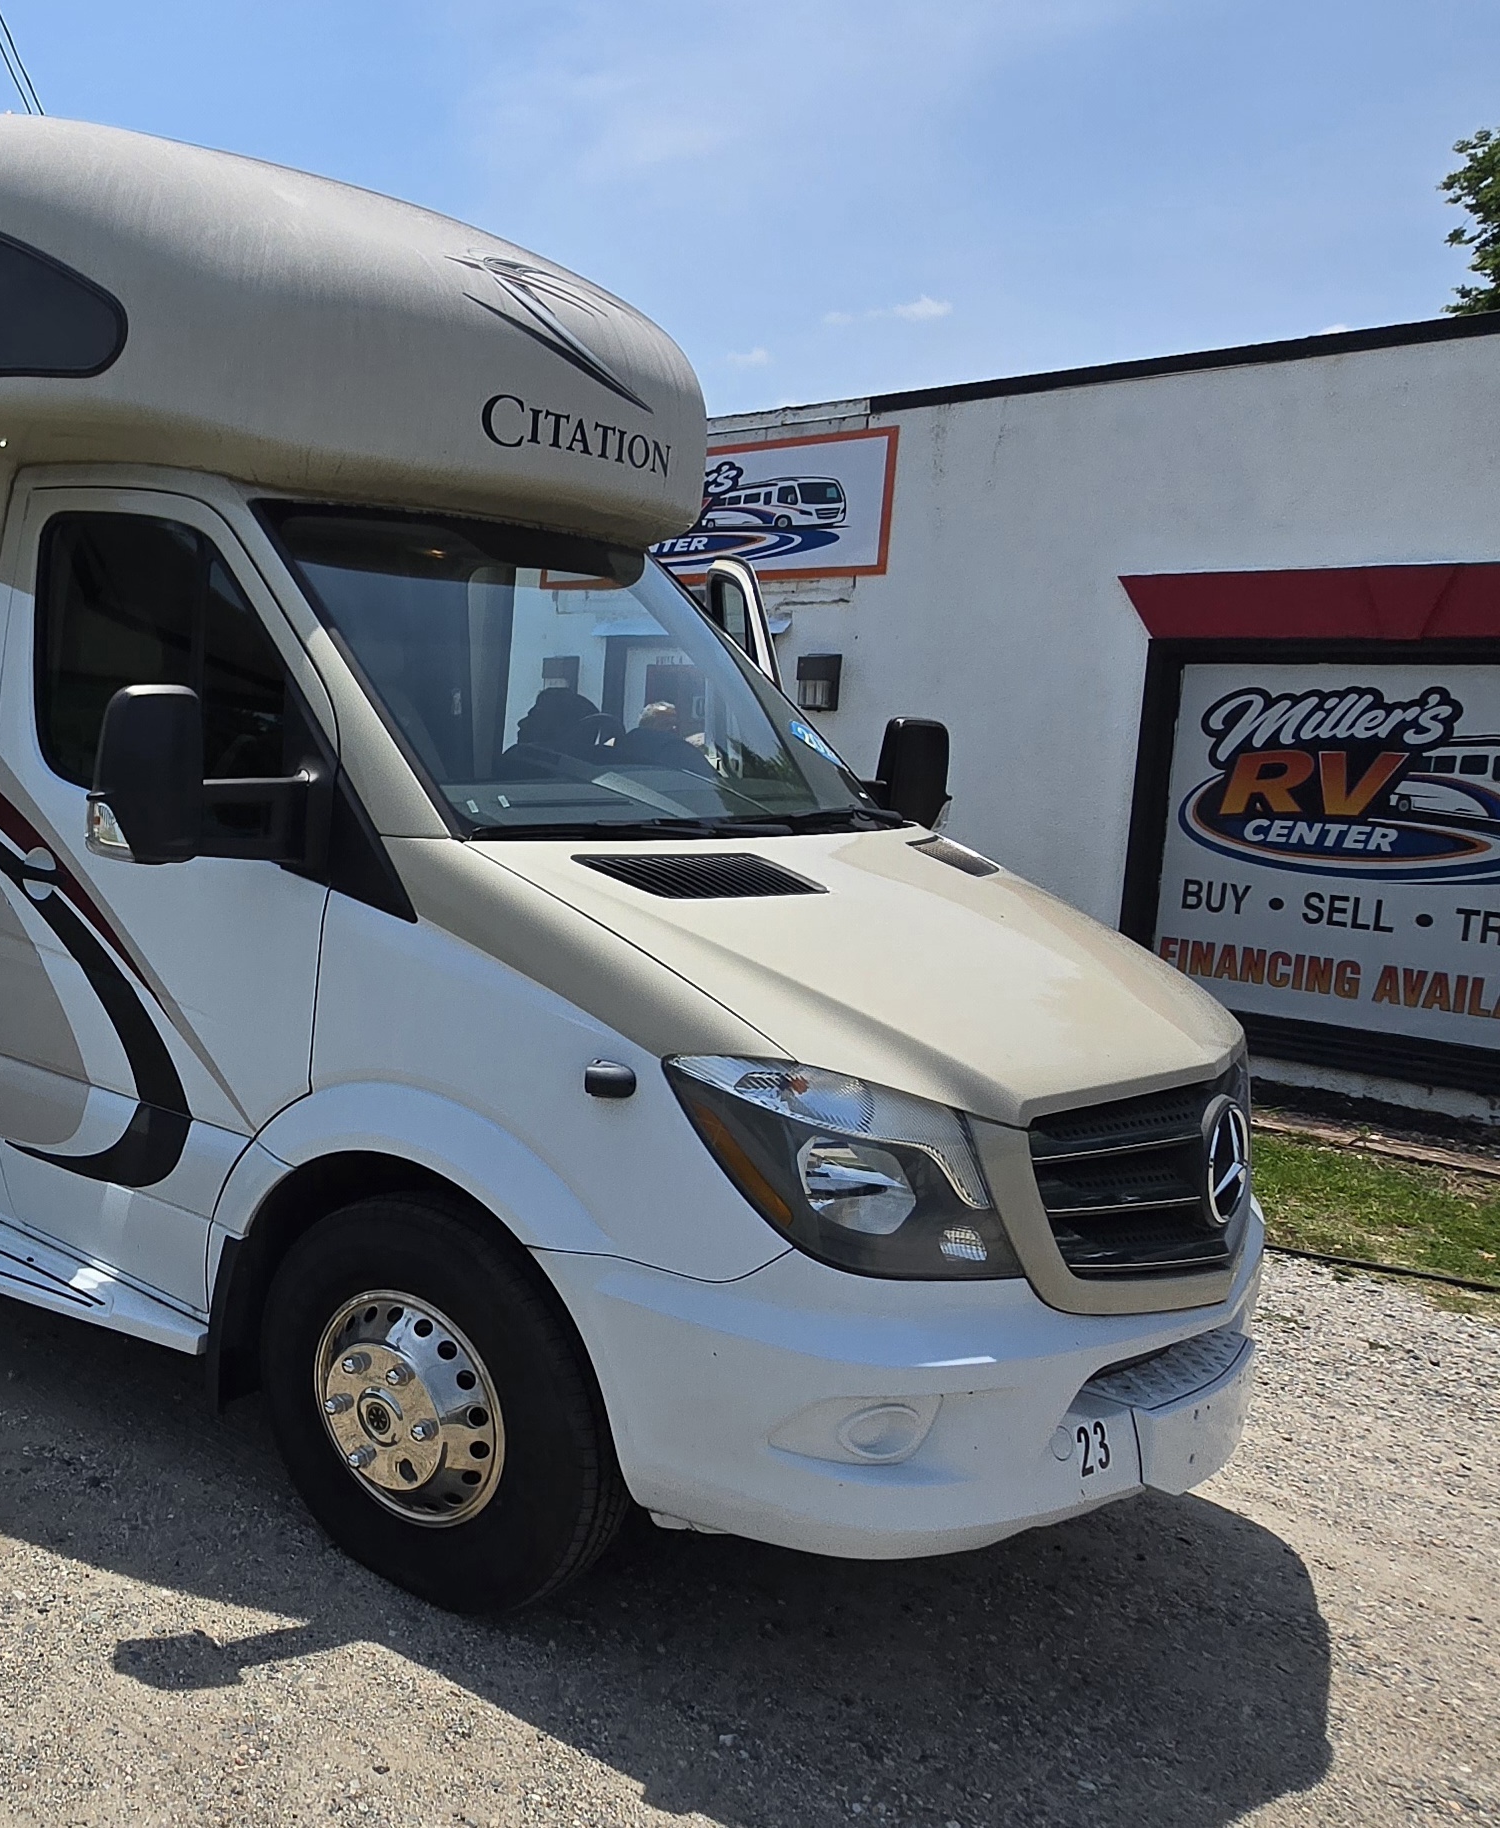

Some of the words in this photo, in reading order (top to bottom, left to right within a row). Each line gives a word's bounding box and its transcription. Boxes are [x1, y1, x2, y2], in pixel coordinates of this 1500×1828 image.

[481, 394, 672, 478] CITATION
[1209, 693, 1453, 763] Miller's
[1219, 750, 1410, 816] RV
[1243, 818, 1399, 852] CENTER
[1180, 878, 1252, 914] BUY
[1301, 891, 1395, 933] SELL
[1159, 936, 1361, 1000] FINANCING
[1371, 965, 1500, 1019] AVAIL
[1076, 1420, 1110, 1478] 23
